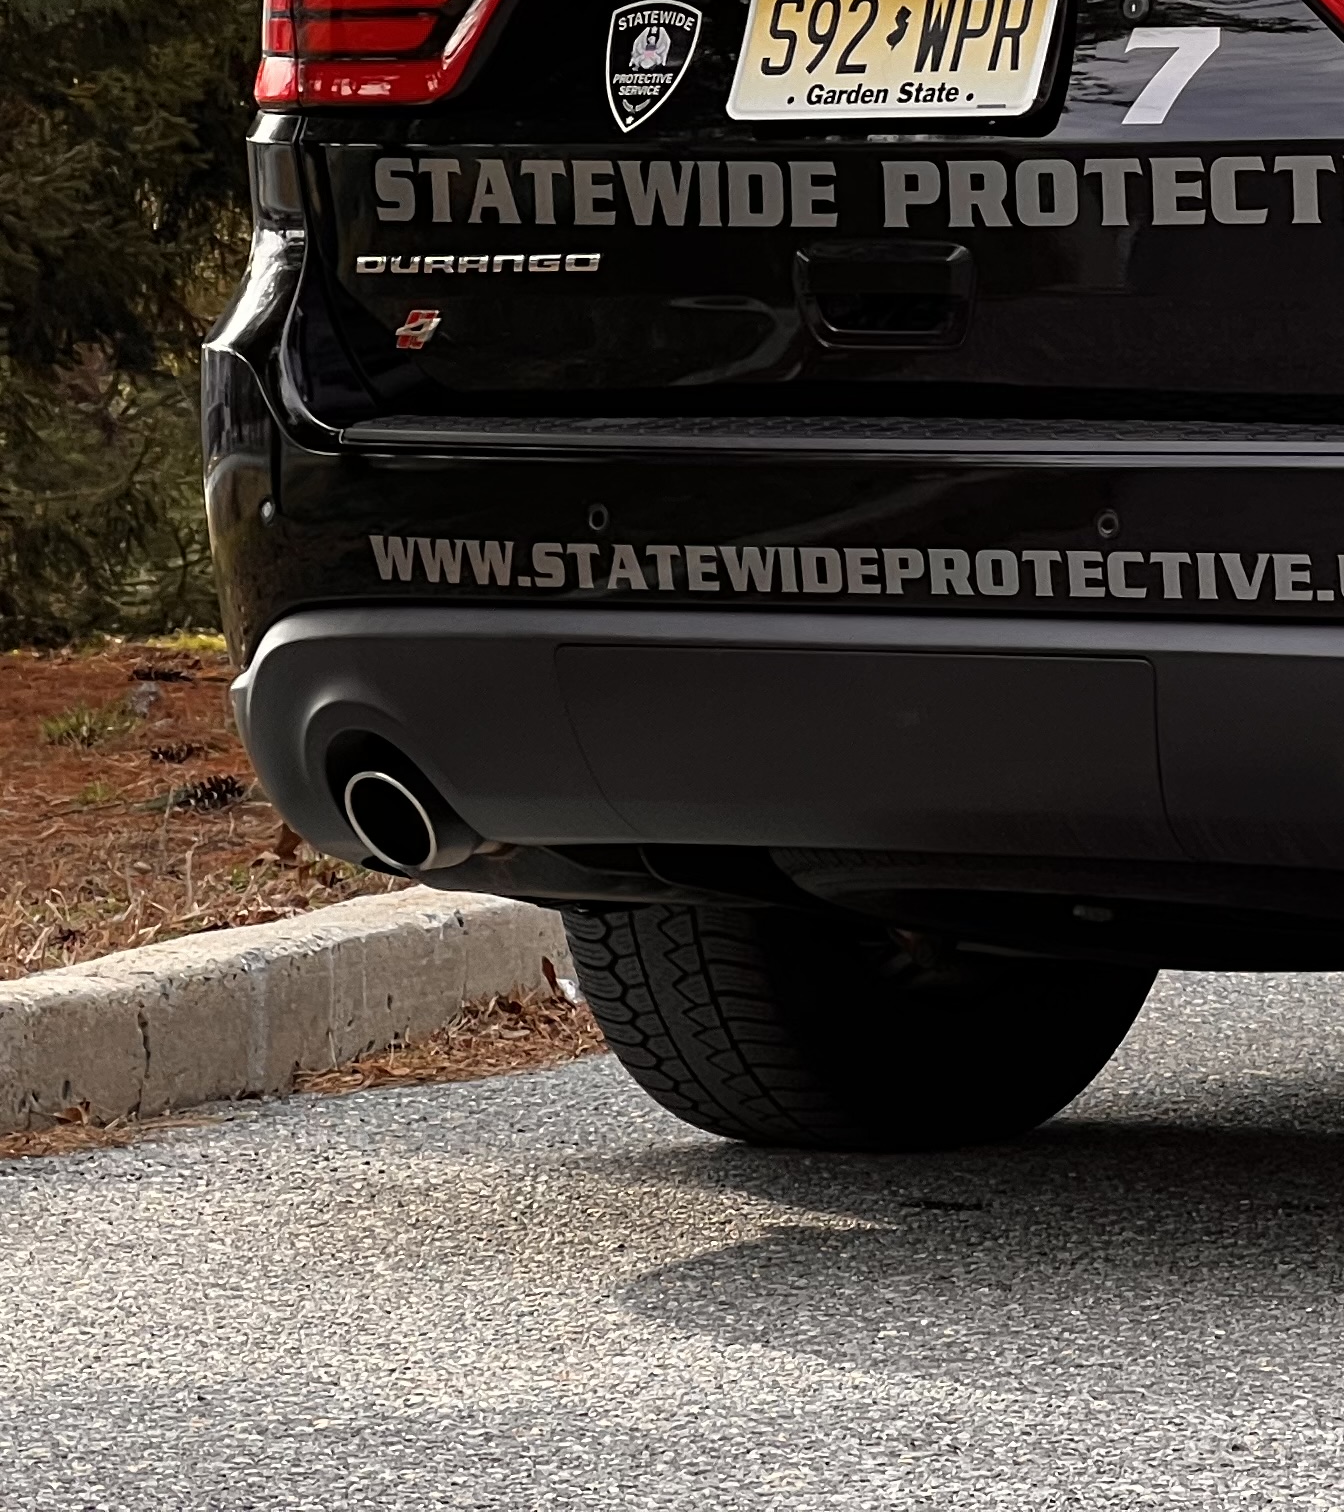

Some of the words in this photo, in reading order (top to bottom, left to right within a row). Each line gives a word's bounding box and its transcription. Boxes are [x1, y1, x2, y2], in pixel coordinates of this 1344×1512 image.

[618, 10, 695, 31] STATEWIDE
[612, 73, 674, 84] PROTECTIVE
[1121, 27, 1221, 125] 7
[618, 85, 661, 96] SERVICE
[806, 83, 887, 106] Garden
[896, 82, 960, 104] State
[374, 157, 839, 228] STATEWIDE
[356, 253, 601, 274] DURANGO
